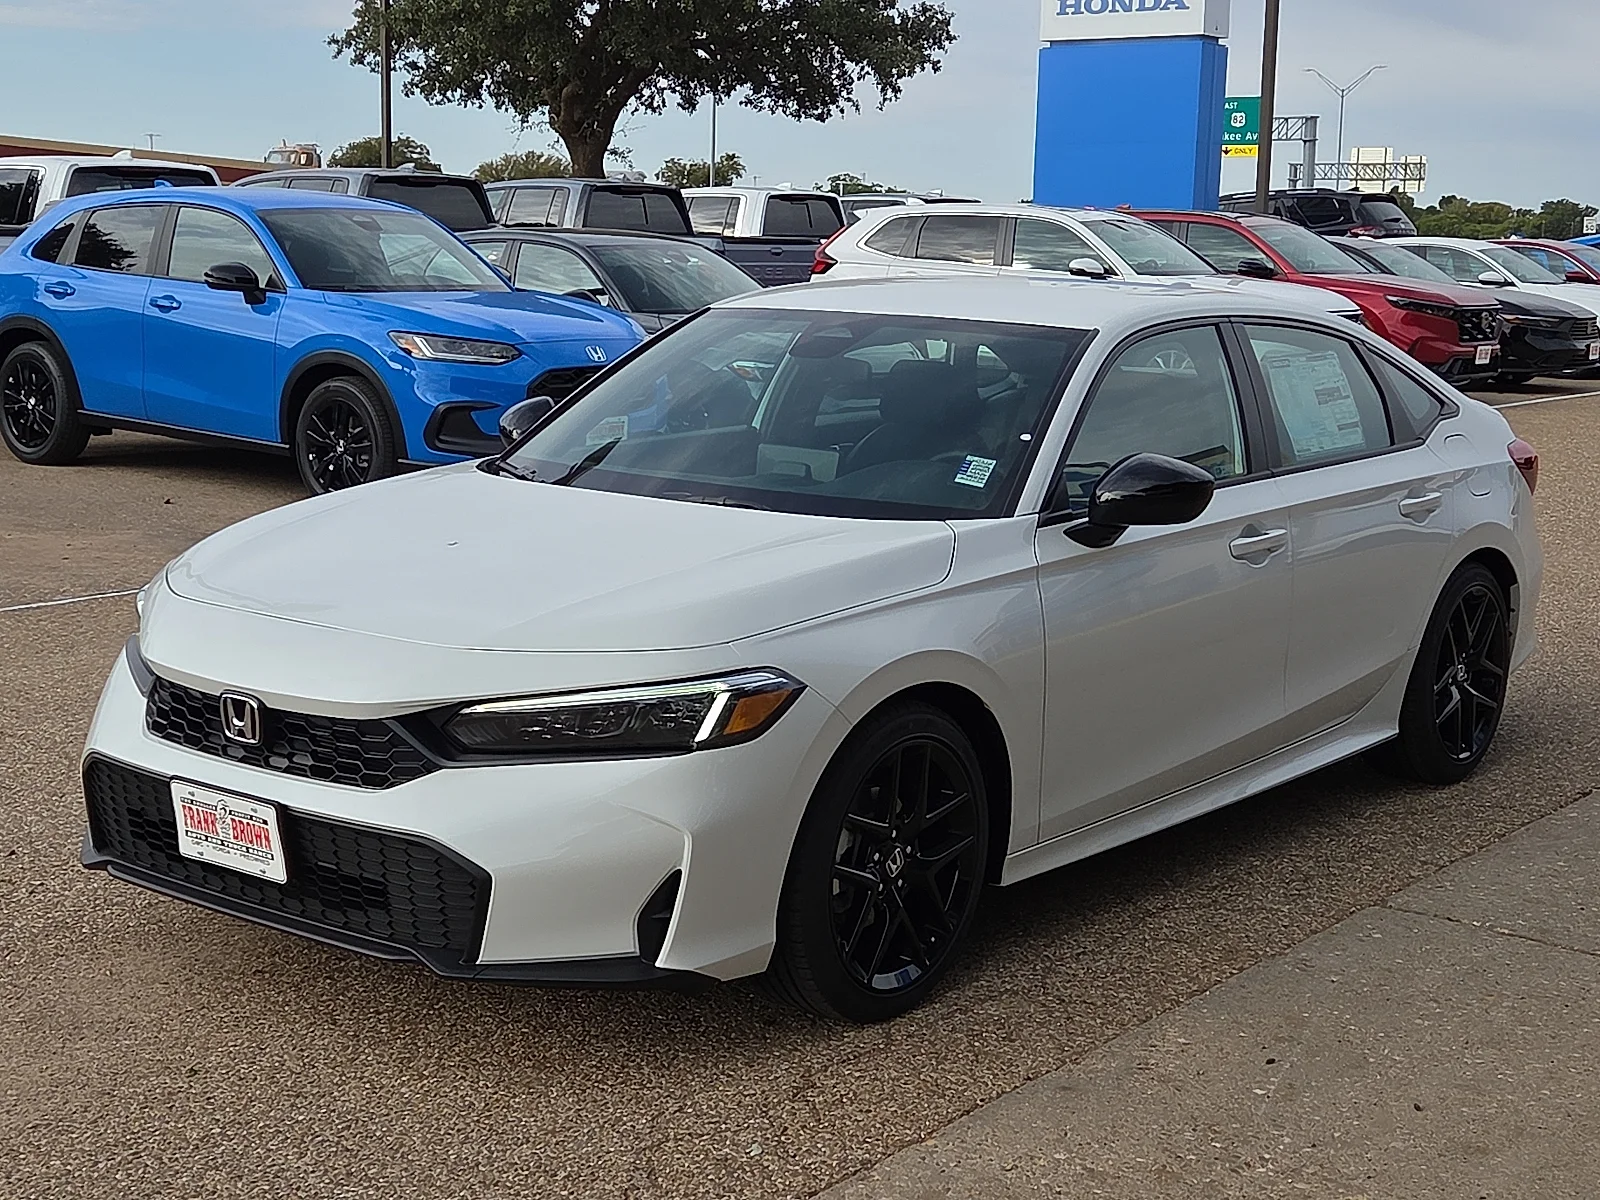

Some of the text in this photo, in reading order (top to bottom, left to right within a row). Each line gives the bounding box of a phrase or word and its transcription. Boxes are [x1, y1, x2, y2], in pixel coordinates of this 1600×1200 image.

[1056, 0, 1190, 15] HONDA
[1224, 101, 1238, 109] AST
[1232, 115, 1244, 124] 82
[1222, 131, 1259, 141] kee Av
[1234, 147, 1254, 155] ONLY
[181, 804, 272, 851] FRANK BROWN
